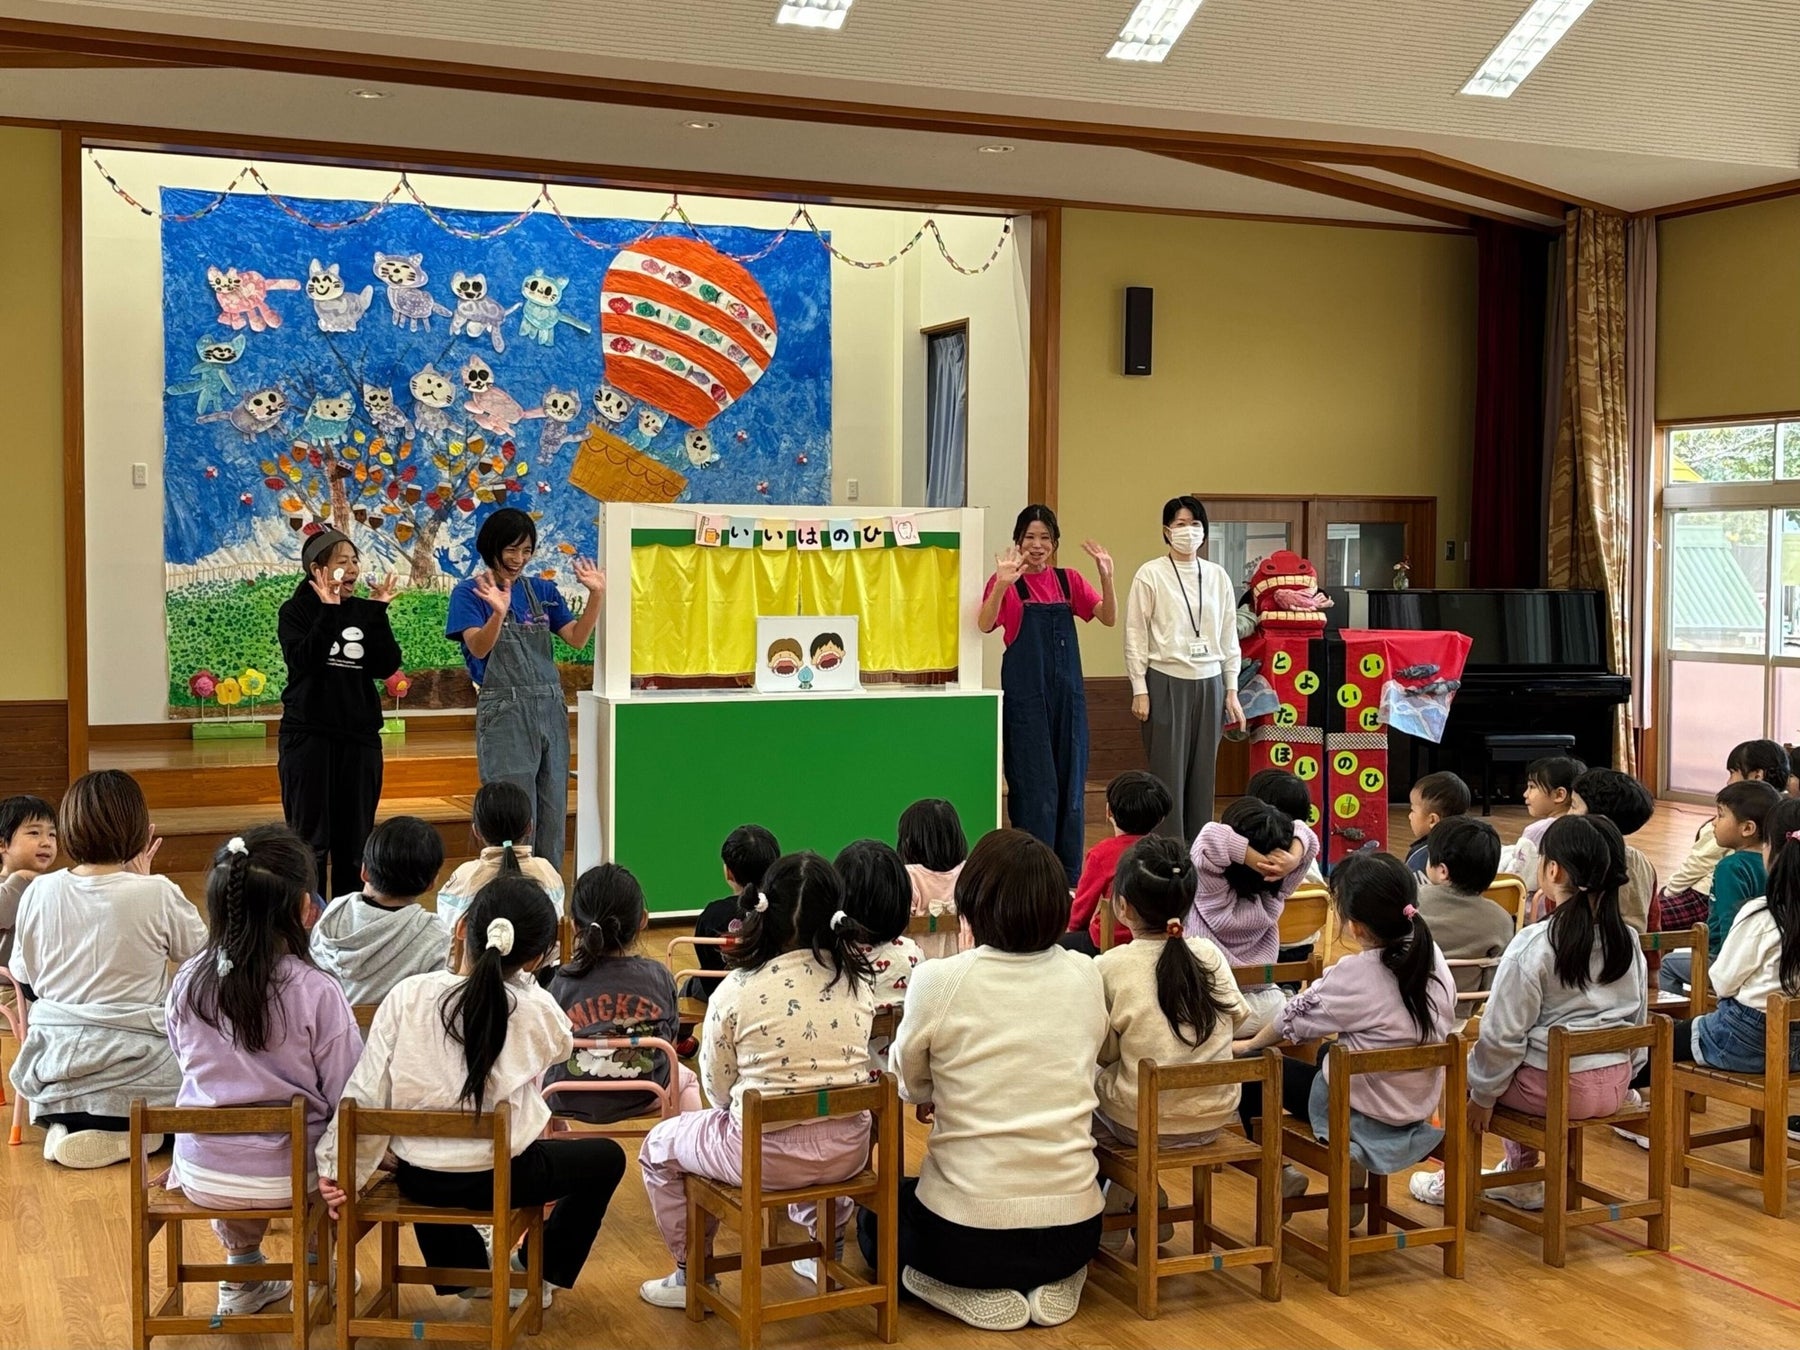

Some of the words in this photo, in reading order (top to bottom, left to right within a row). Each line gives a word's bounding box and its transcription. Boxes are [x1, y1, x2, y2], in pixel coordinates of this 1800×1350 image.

[730, 525, 882, 545] いいはのひ
[1273, 654, 1317, 823] とよたほい
[1337, 658, 1382, 788] いいはのひ
[566, 993, 664, 1032] MICKEY
